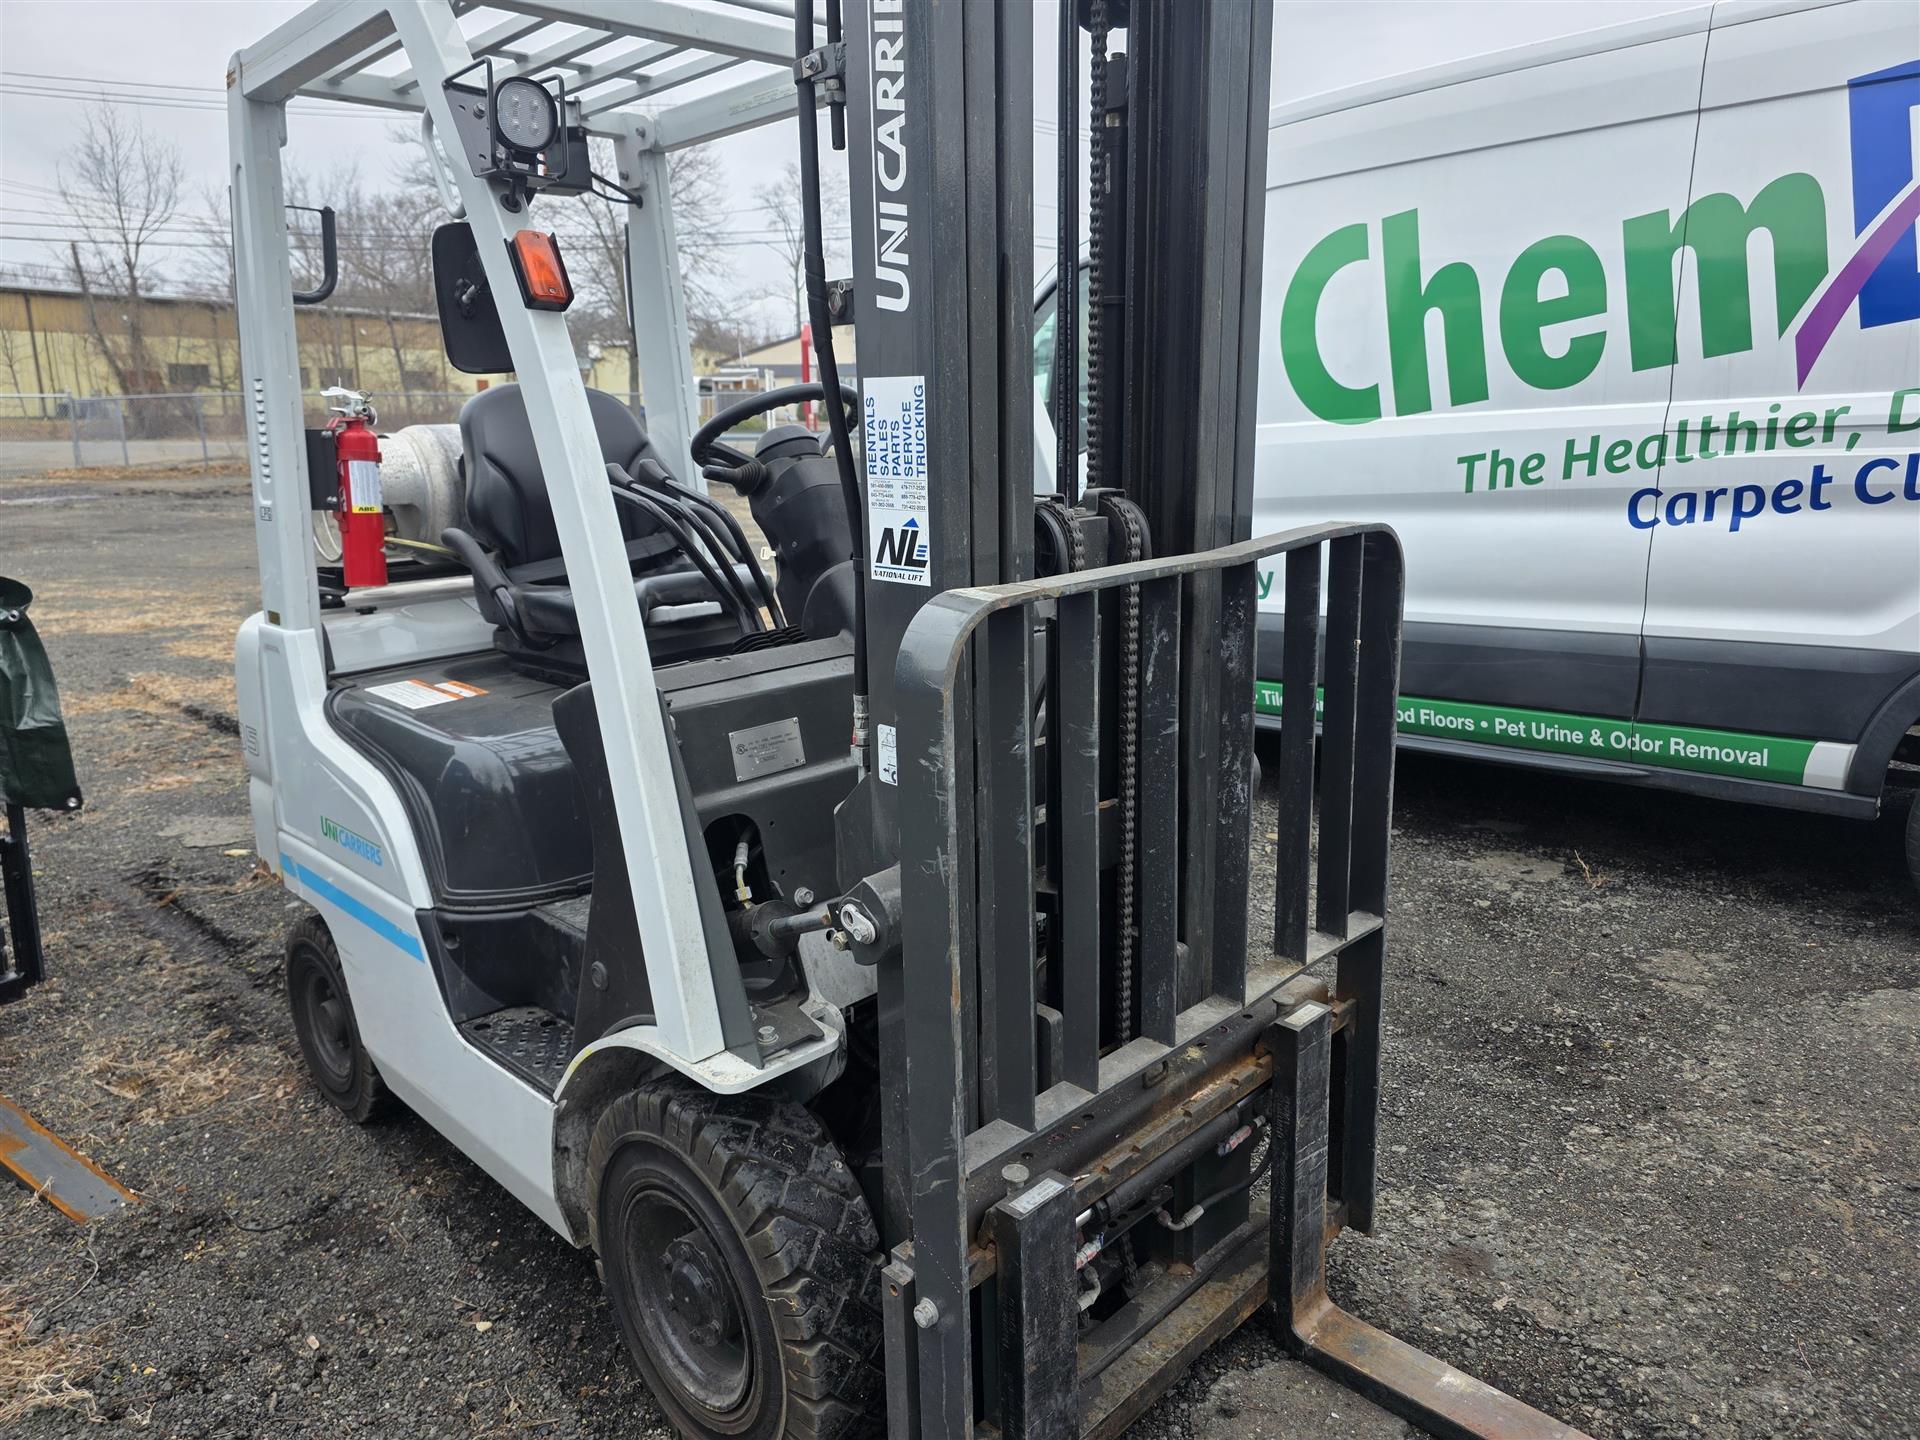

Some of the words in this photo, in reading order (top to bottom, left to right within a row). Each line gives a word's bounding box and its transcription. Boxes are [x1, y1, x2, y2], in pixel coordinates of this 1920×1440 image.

[866, 397, 877, 475] RENTALS
[878, 419, 889, 476] SALES
[890, 420, 901, 477] PARTS
[902, 401, 913, 477] SERVICE
[914, 384, 926, 478] TRUCKING
[1457, 449, 1546, 494] The
[1562, 403, 1862, 481] Healthier,
[1627, 464, 1834, 532] Carpet
[874, 570, 906, 580] NATIONAL
[907, 573, 923, 582] LIFT
[1420, 709, 1475, 731] Floors
[1494, 717, 1527, 738] Pet
[1531, 722, 1584, 744] Urine
[1589, 728, 1605, 747] &
[1610, 731, 1664, 753] Odor
[1669, 737, 1769, 767] Removal
